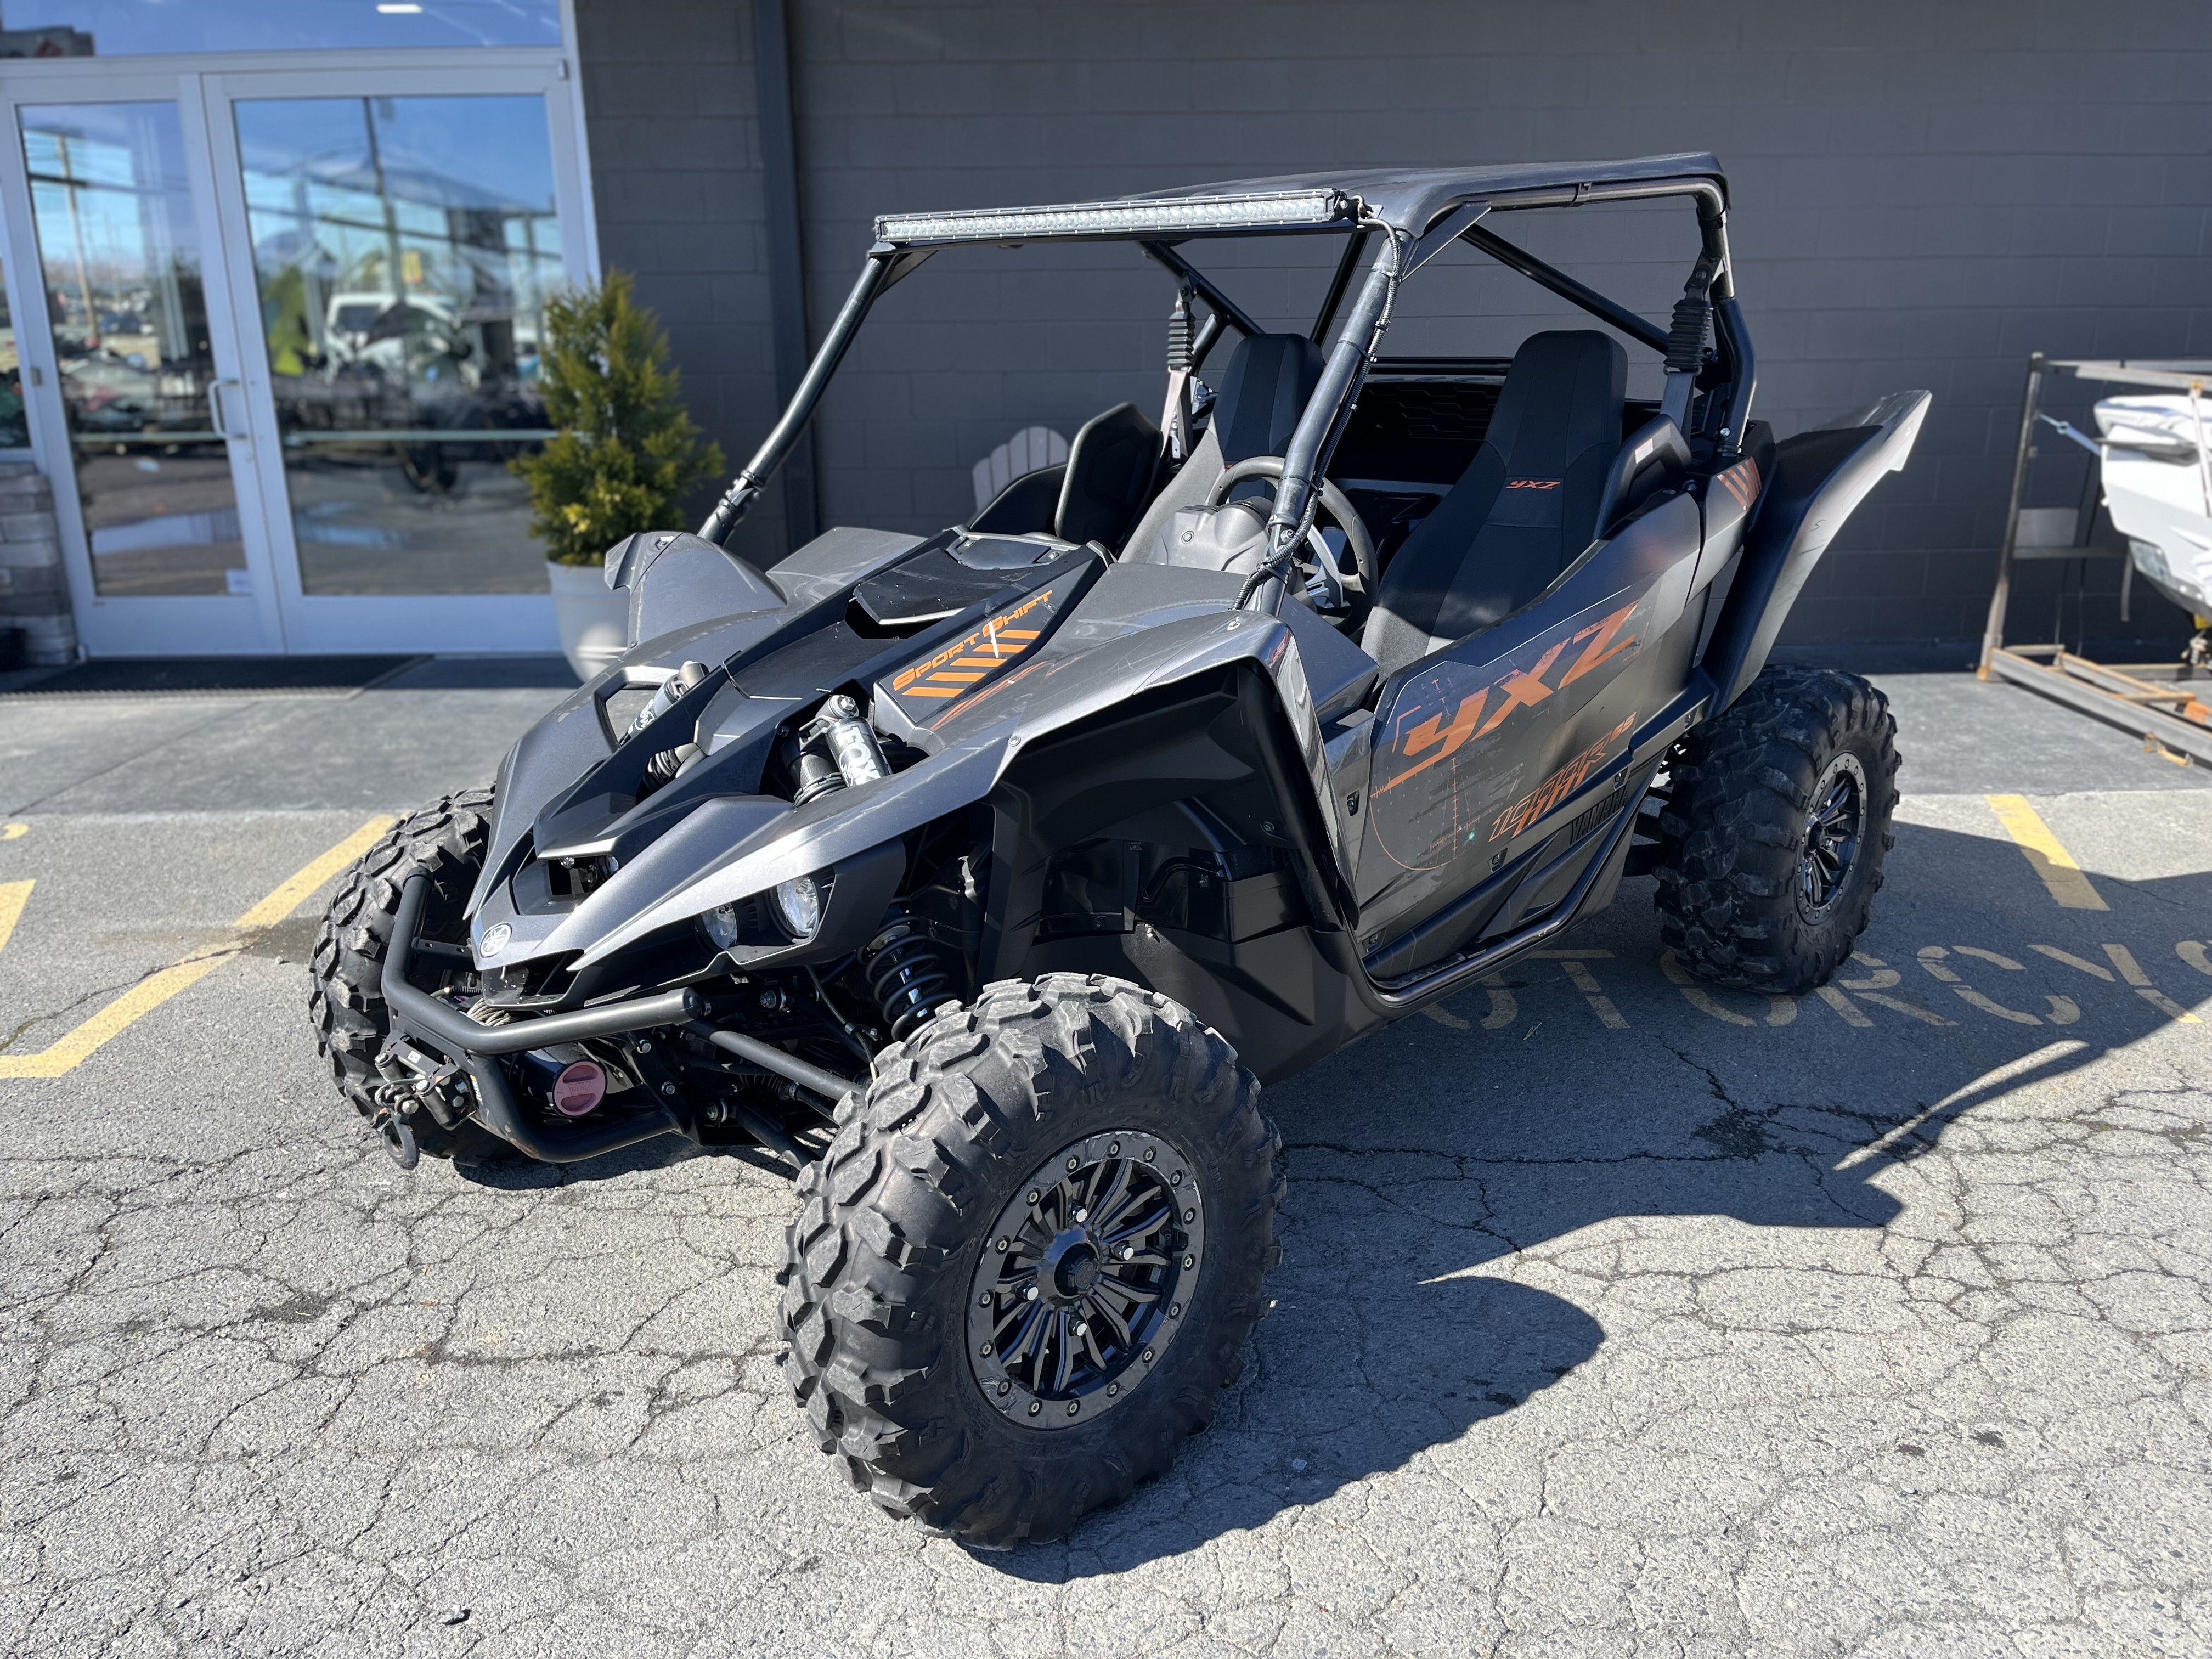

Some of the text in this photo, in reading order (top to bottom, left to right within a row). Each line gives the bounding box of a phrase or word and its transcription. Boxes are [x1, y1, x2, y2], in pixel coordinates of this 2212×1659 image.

[1506, 480, 1561, 489] YXZ
[893, 590, 1052, 691] SPORT SHIFT
[1388, 599, 1639, 790] YXZ
[835, 725, 881, 787] FOX
[1570, 781, 1630, 845] YAMAHA
